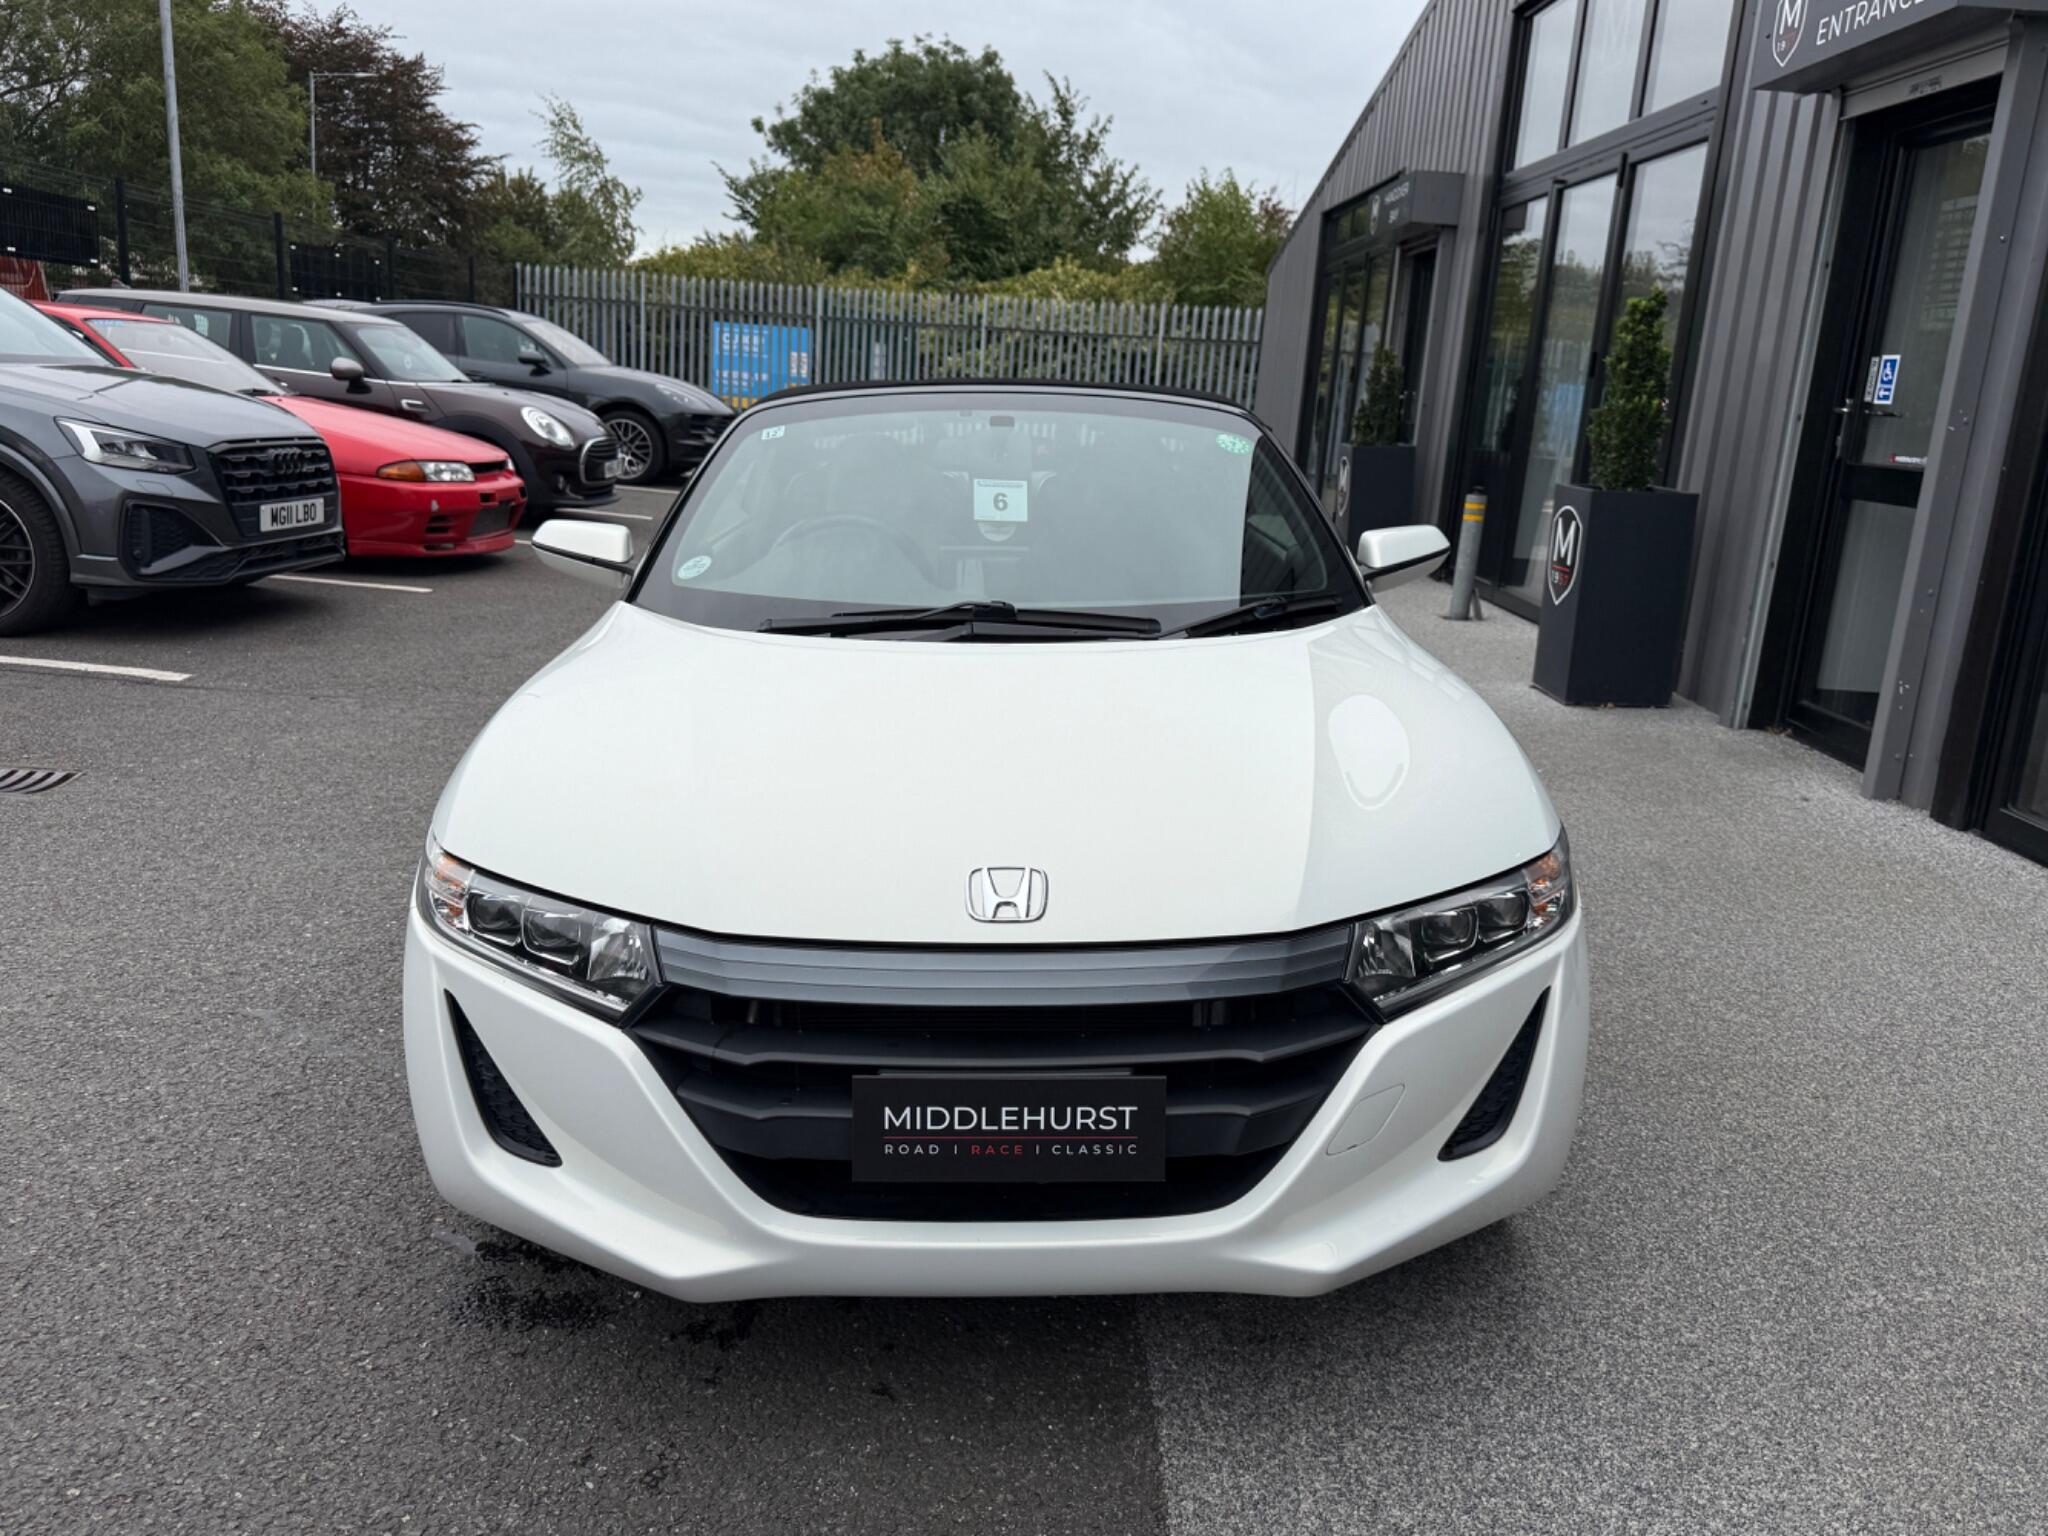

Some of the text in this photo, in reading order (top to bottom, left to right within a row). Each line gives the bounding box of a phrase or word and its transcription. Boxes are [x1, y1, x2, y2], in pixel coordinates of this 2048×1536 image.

[1779, 0, 1802, 35] M
[1816, 0, 1925, 46] ENTRAN
[993, 492, 1008, 511] 6
[1553, 517, 1576, 566] M
[883, 1106, 1138, 1130] MIDDLEHURST
[884, 1144, 940, 1155] ROAD
[971, 1144, 1024, 1155] RACE
[1051, 1143, 1138, 1155] CLASSIC
